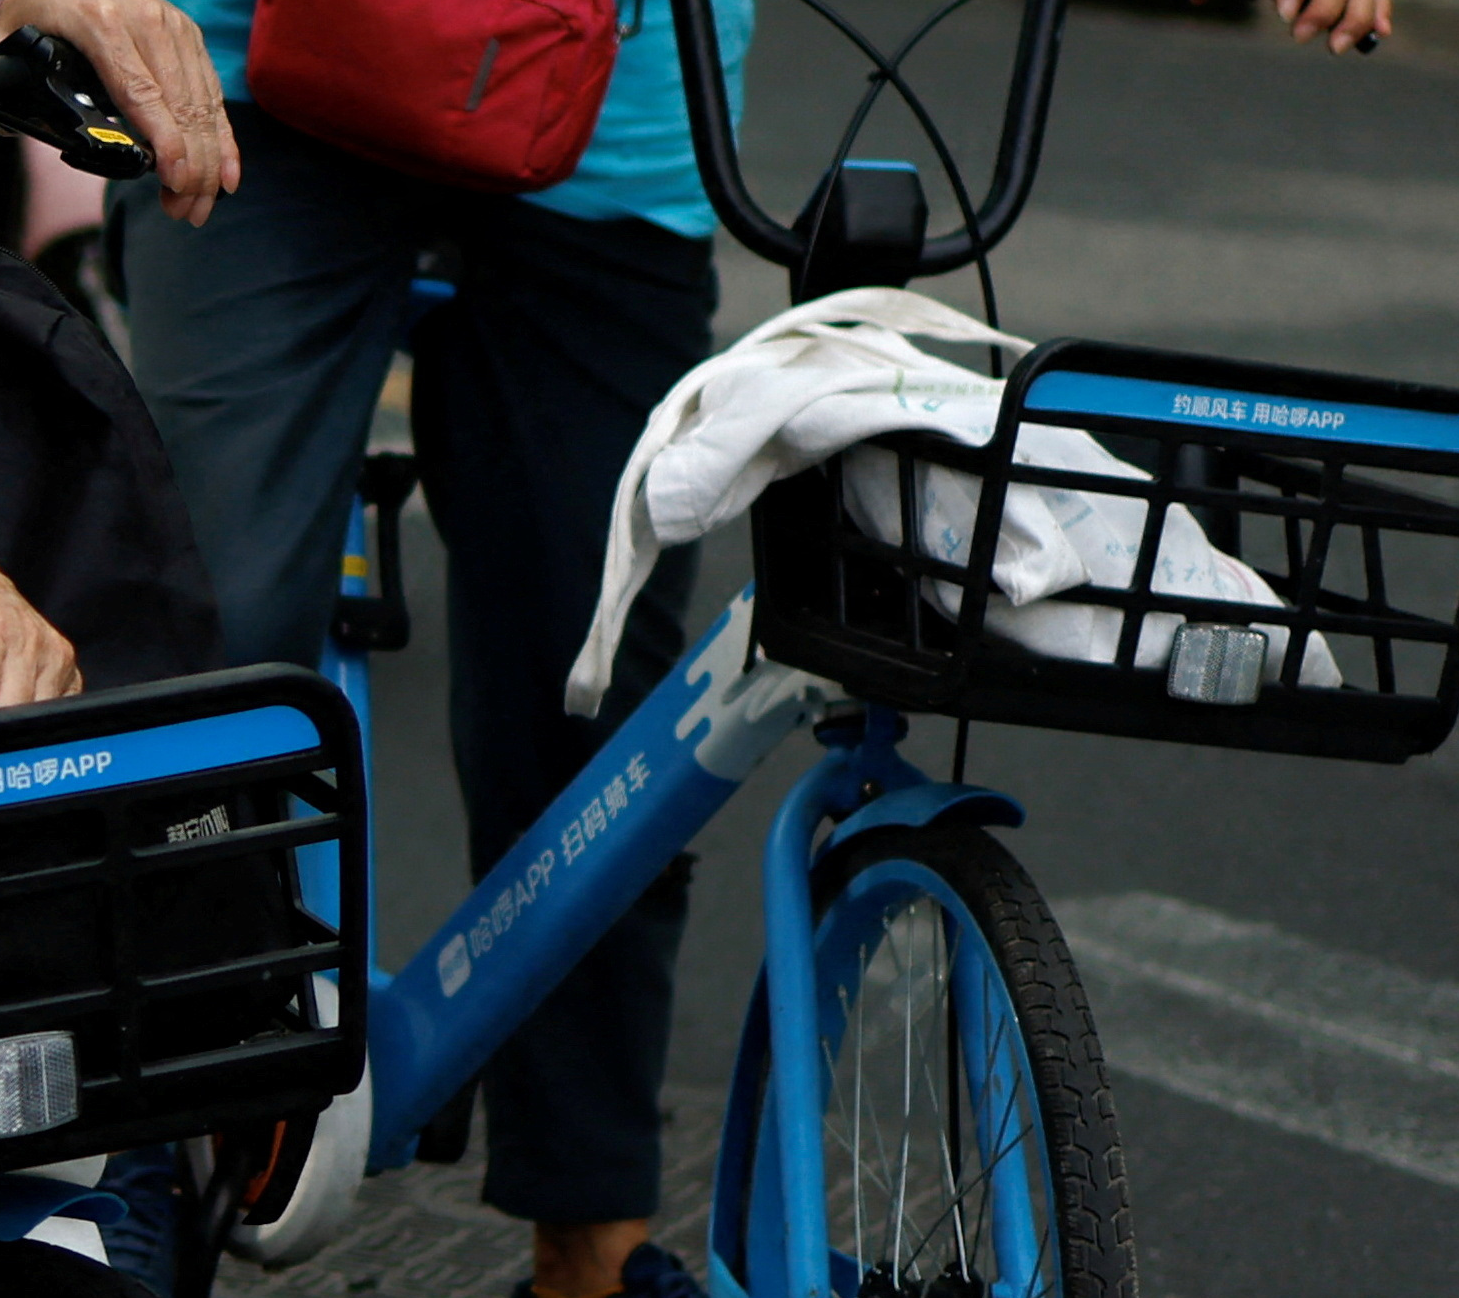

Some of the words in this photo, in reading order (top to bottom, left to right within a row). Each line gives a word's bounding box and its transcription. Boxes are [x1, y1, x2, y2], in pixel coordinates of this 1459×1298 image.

[1171, 393, 1249, 422] 约顺风车
[1251, 401, 1346, 431] 用哈啰APP
[560, 750, 652, 867] 扫码骑车
